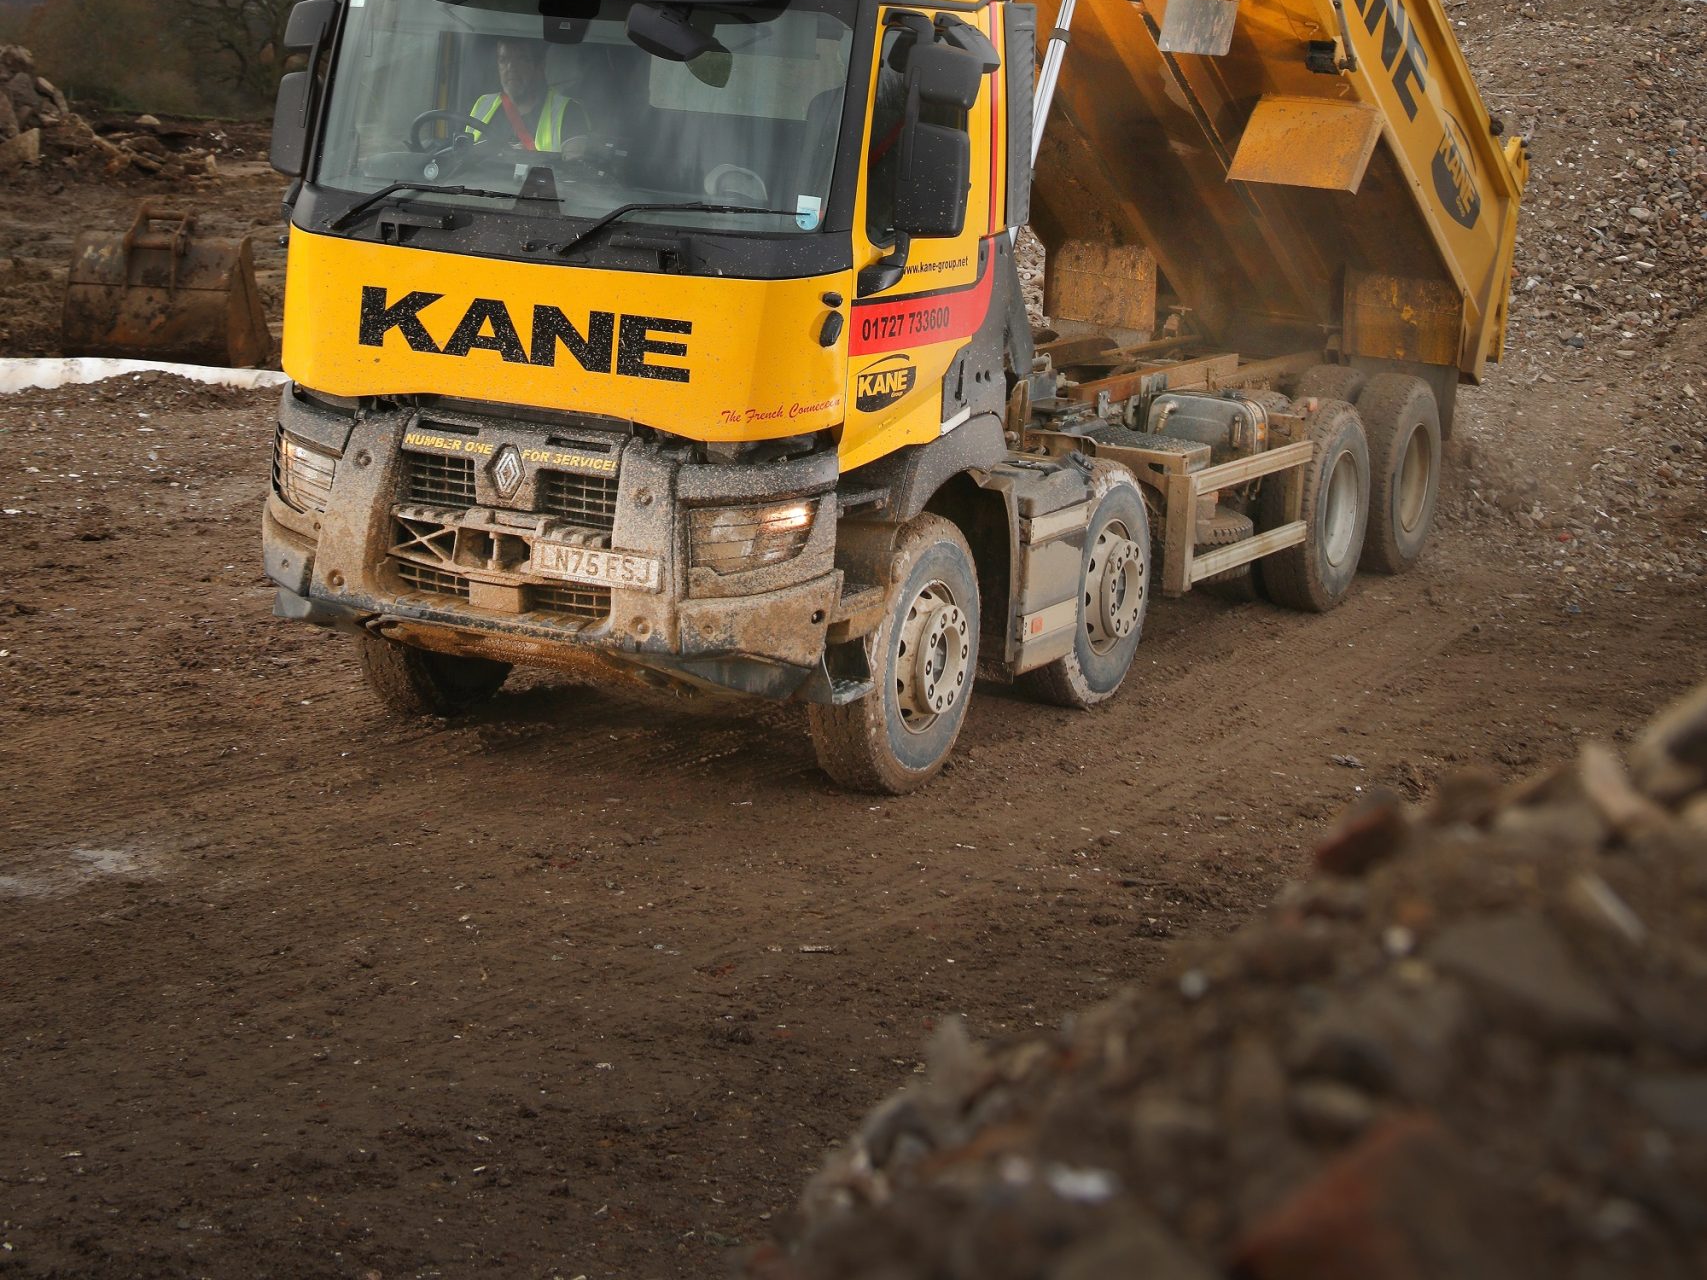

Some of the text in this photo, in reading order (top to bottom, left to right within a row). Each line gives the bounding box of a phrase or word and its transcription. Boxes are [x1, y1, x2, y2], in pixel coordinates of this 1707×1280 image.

[358, 285, 693, 383] KANE
[862, 306, 950, 341] 01727 733600
[858, 370, 908, 398] KANE
[721, 410, 742, 423] The
[745, 405, 783, 423] French
[404, 433, 461, 451] NUMBER
[464, 441, 494, 456] ONE
[522, 449, 549, 463] FOR
